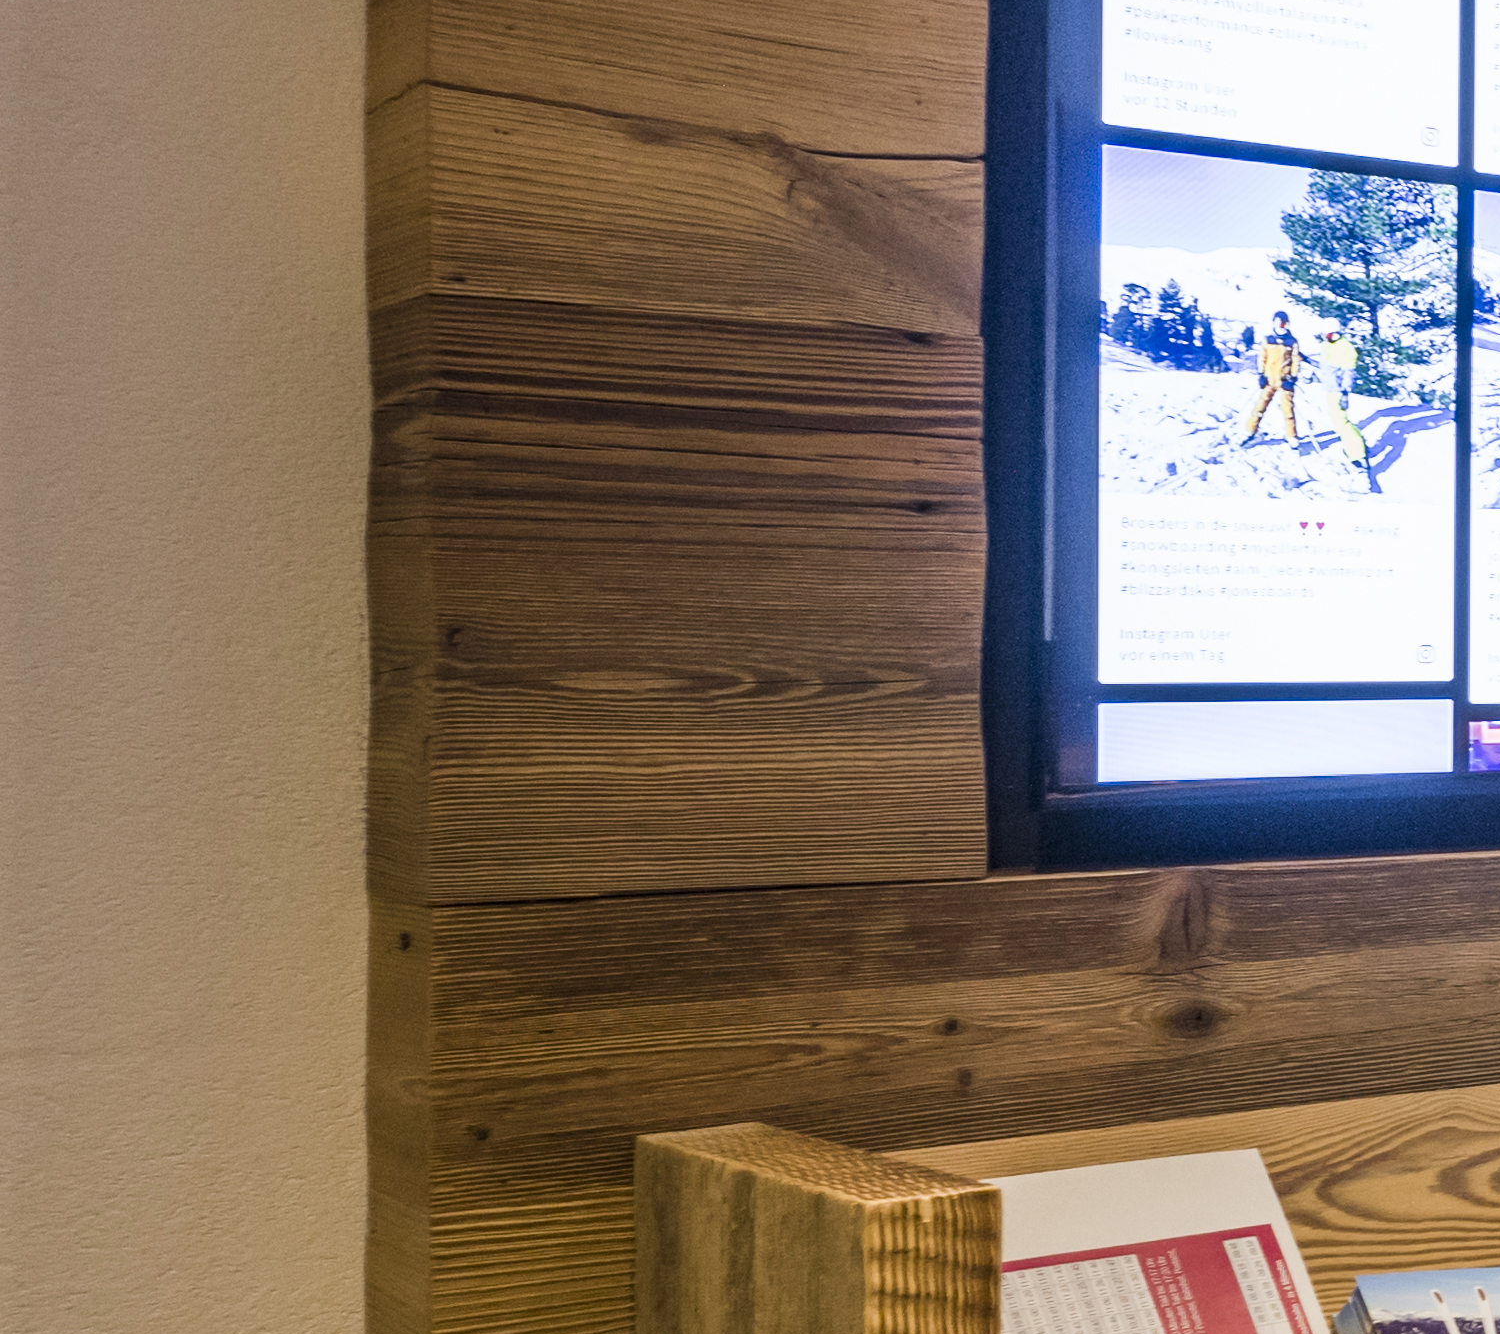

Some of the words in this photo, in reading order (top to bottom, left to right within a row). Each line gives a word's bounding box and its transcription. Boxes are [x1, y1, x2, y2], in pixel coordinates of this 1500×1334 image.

[1124, 71, 1198, 92] Instagram
[1204, 83, 1236, 97] User
[1123, 94, 1146, 107] vor
[1154, 97, 1169, 109] 12
[1175, 101, 1237, 118] Stunden
[1121, 517, 1188, 531] Broeders
[1211, 520, 1227, 532] de
[1120, 628, 1194, 643] Instagram
[1200, 628, 1232, 640] User
[1120, 650, 1144, 661] vor
[1150, 650, 1194, 661] einem
[1200, 649, 1224, 664] Tag
